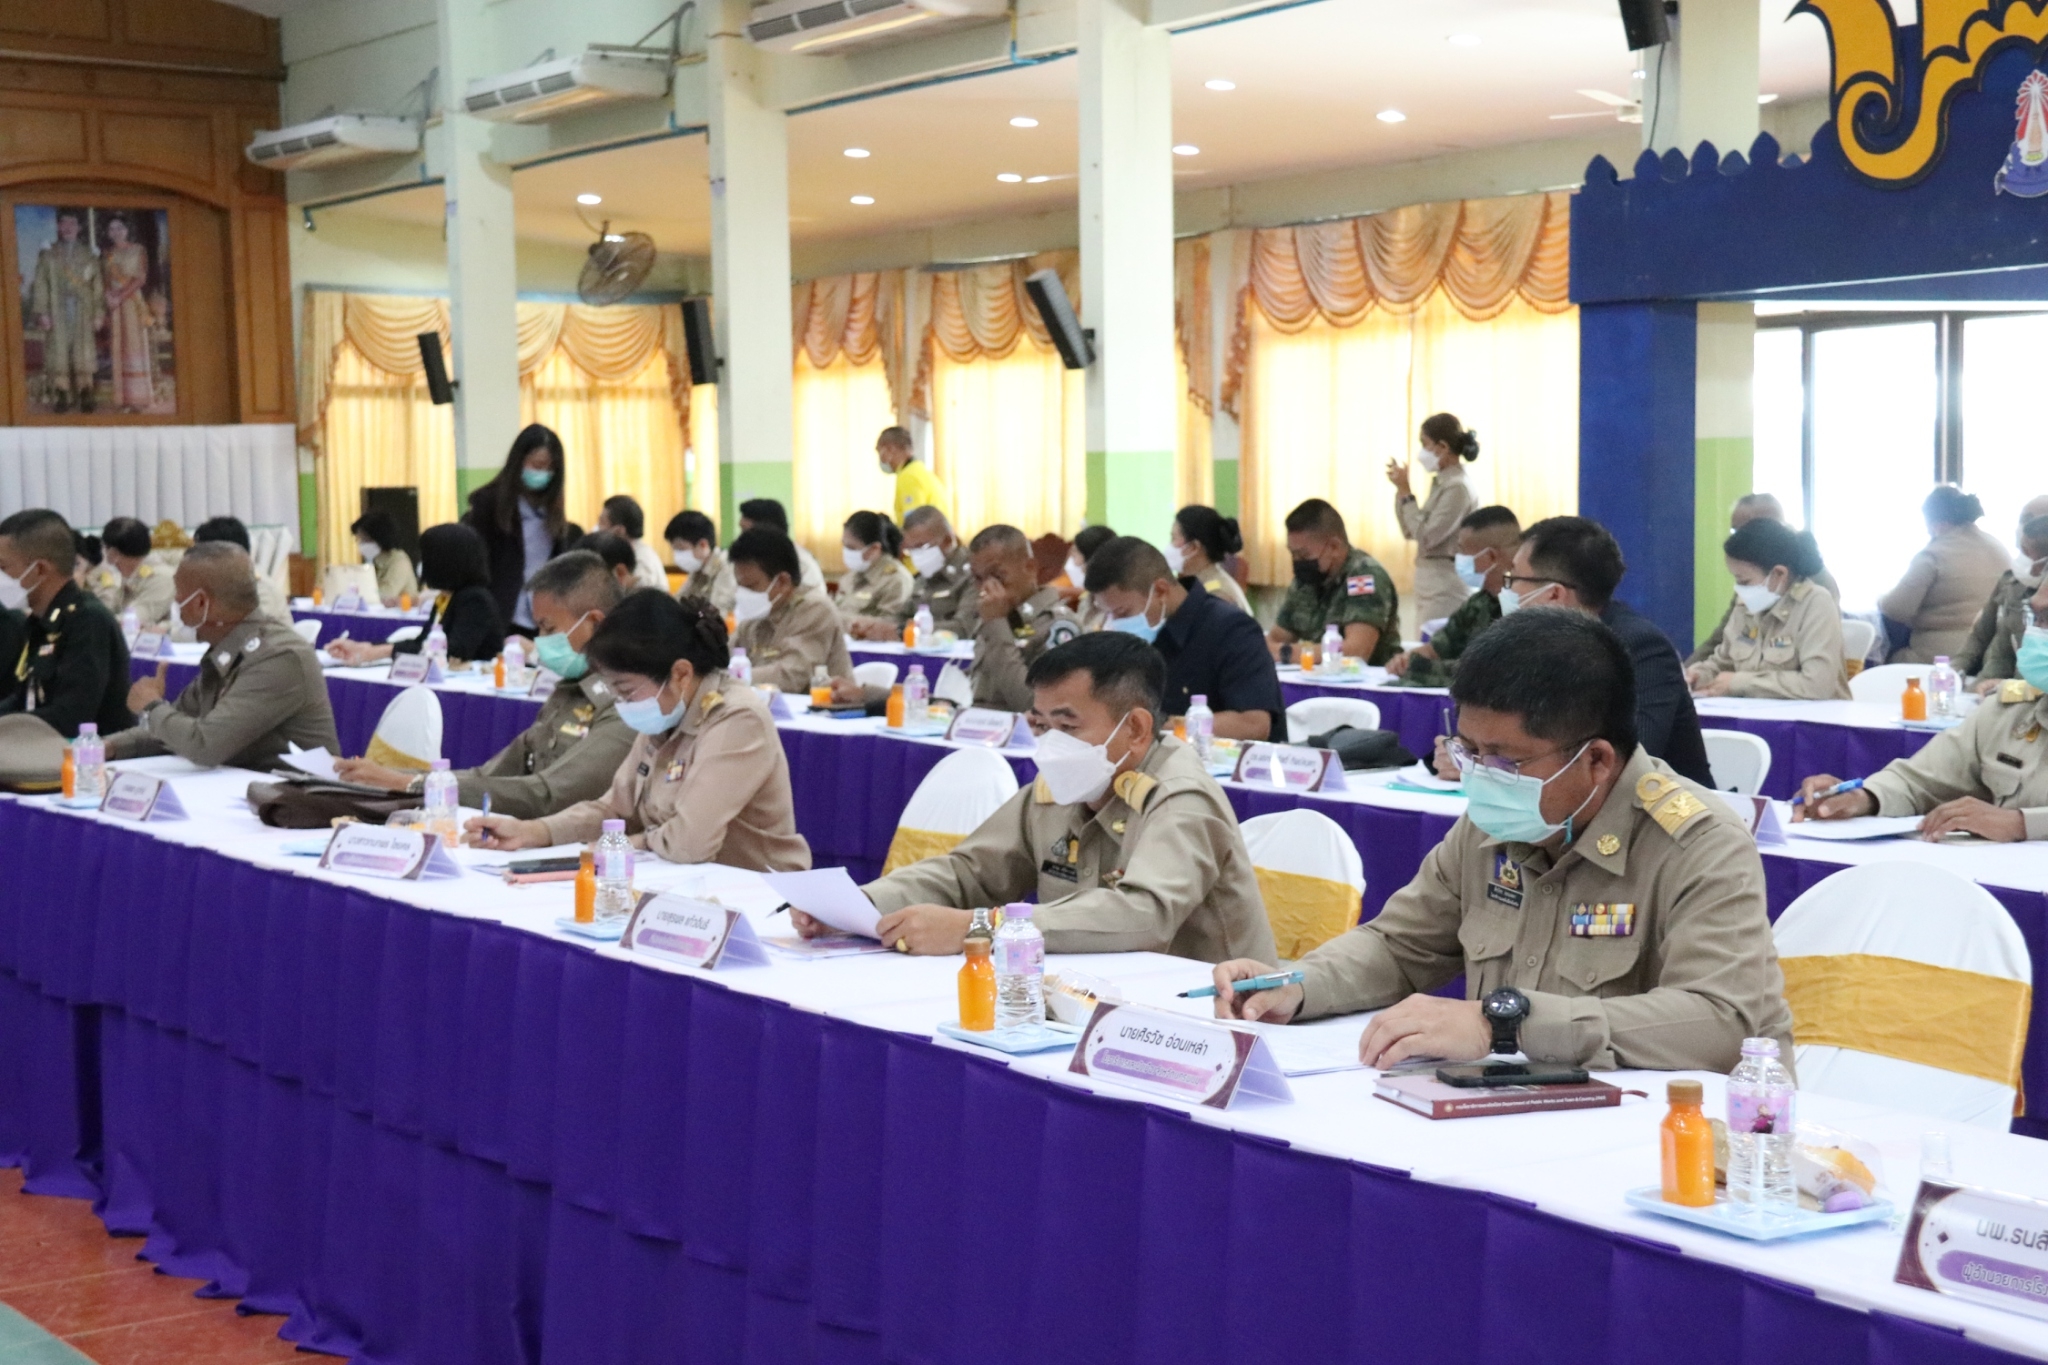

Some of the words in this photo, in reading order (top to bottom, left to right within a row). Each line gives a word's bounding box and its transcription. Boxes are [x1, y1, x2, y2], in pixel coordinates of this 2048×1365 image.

[1119, 1025, 1165, 1046] นายศิรวัช
[1165, 1032, 1209, 1056] อ่อนเหล่า
